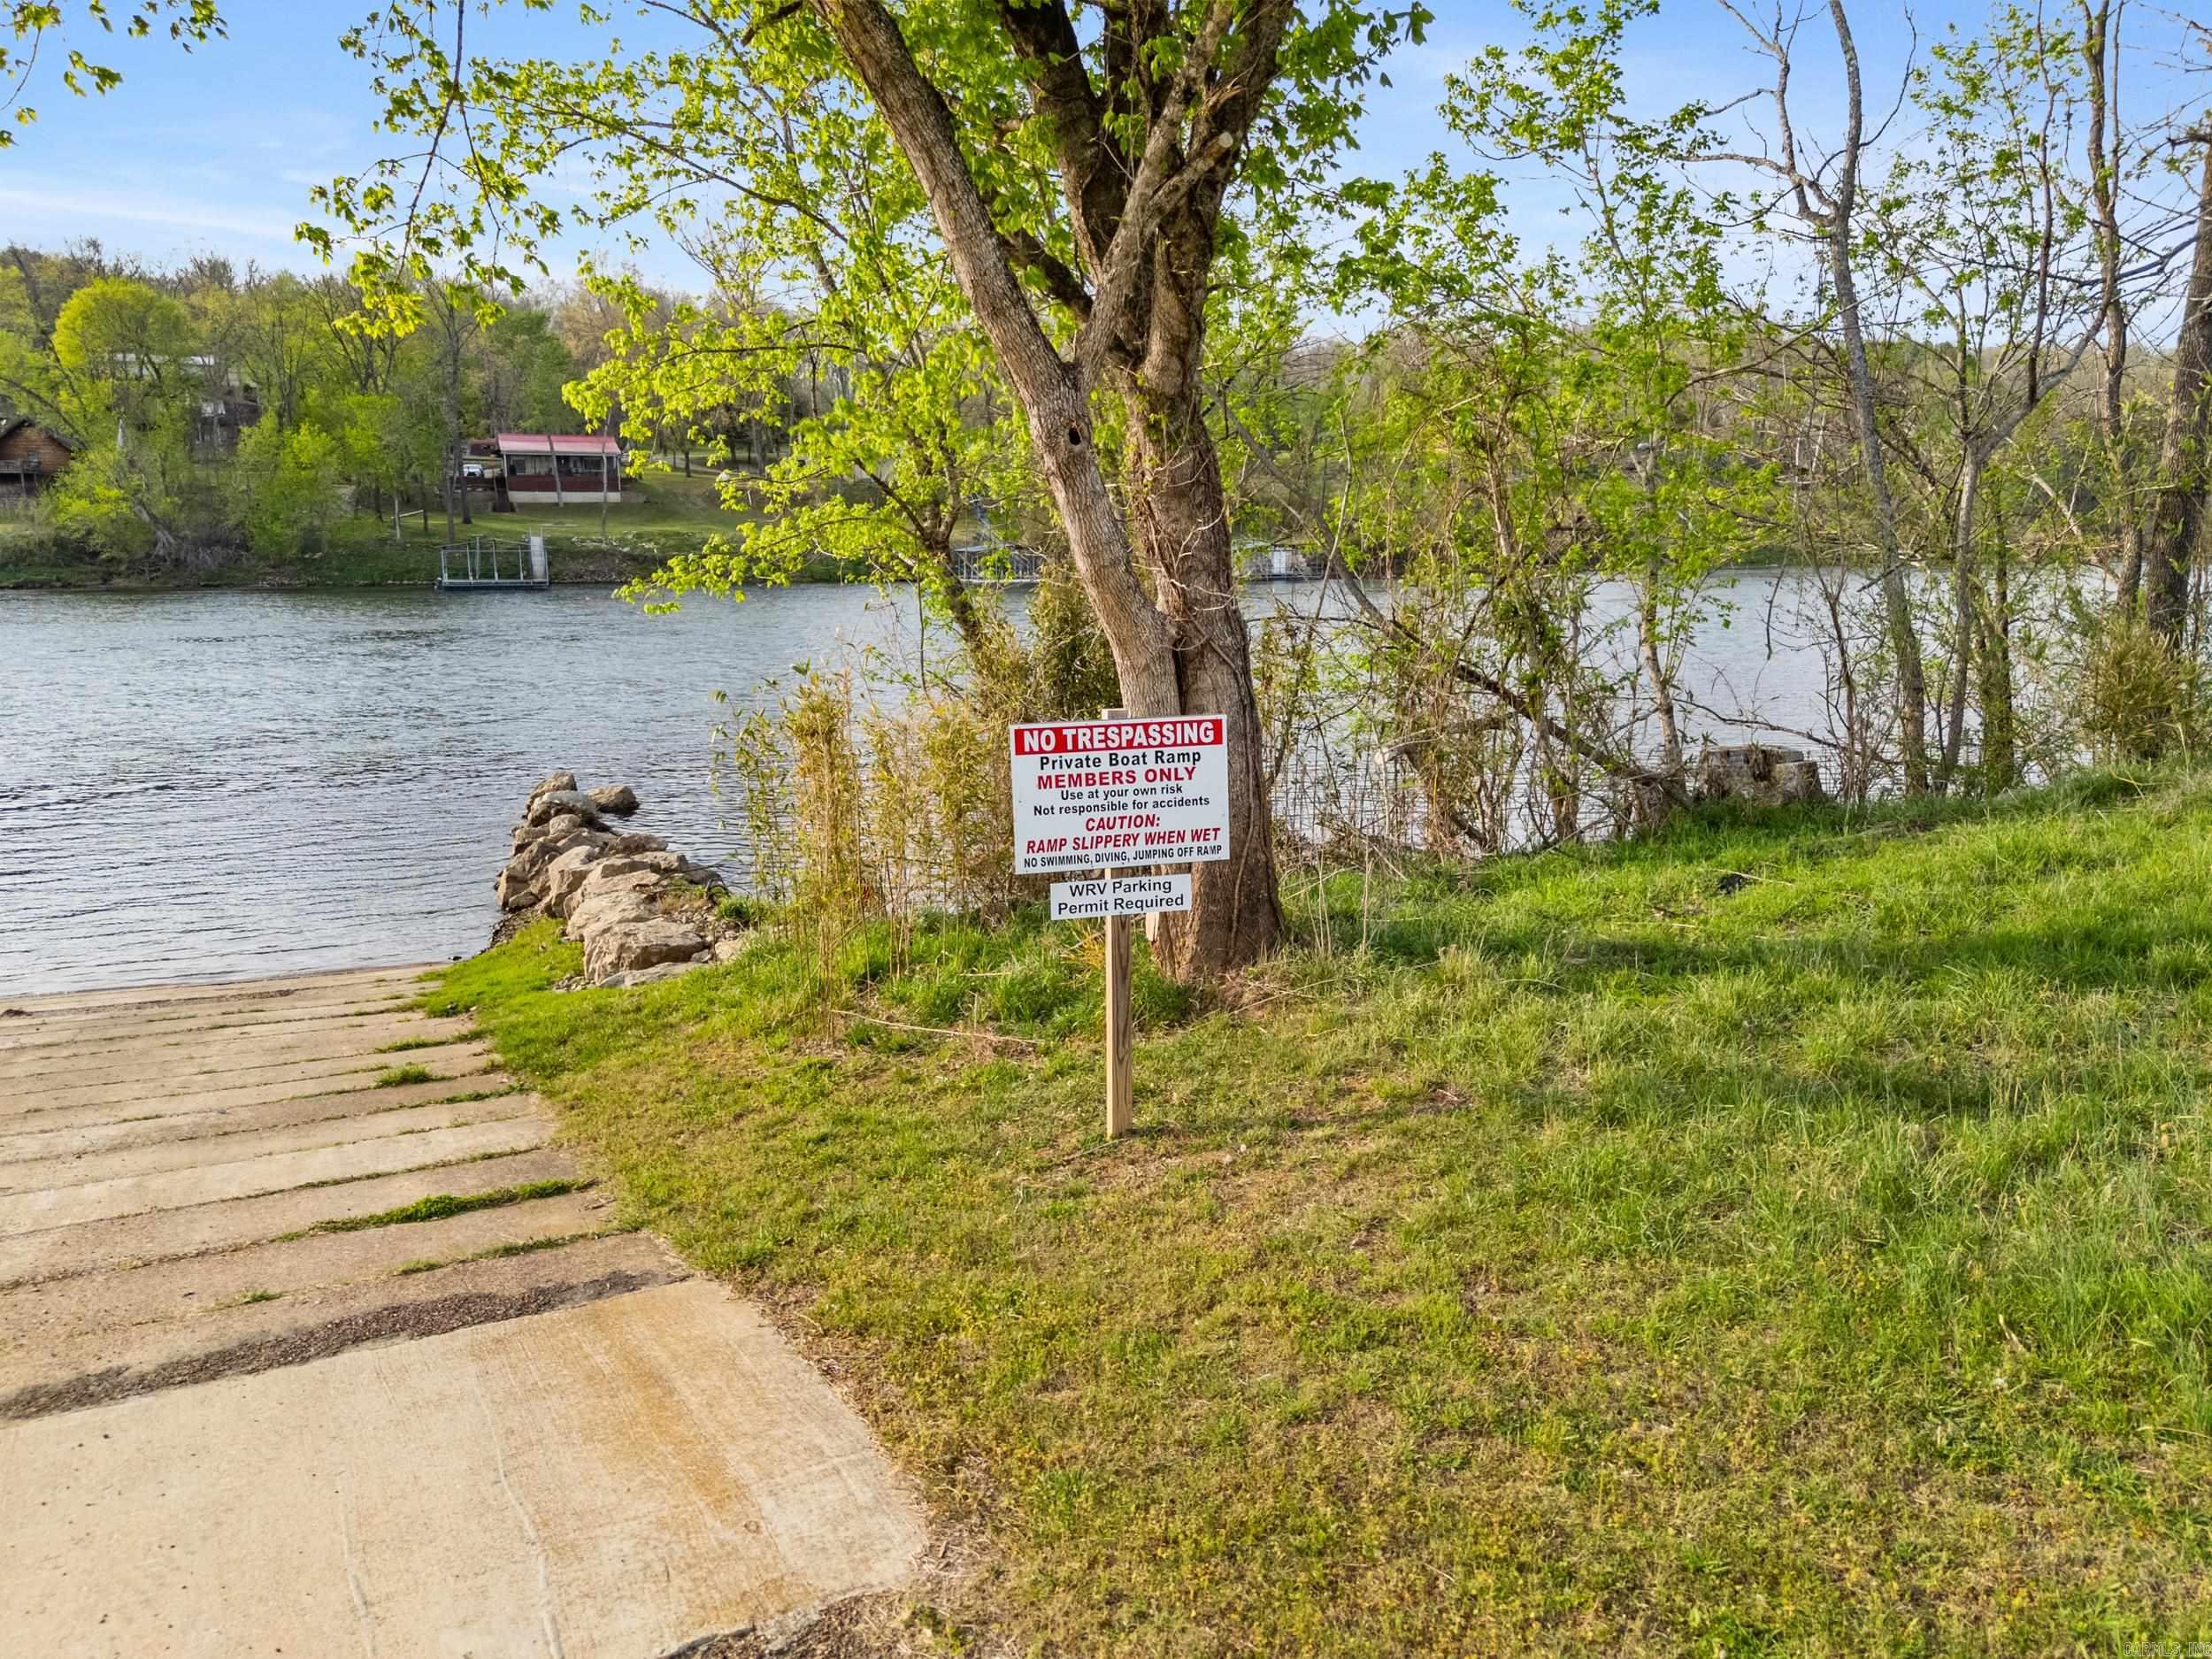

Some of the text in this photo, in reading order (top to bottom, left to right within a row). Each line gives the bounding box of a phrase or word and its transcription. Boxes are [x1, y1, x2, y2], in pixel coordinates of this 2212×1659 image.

[1024, 722, 1214, 752] NO TRESPASSING
[1041, 750, 1201, 770] Private Boat Ramp
[1038, 767, 1196, 789] MEMBERS ONLY
[1061, 785, 1182, 800] Use at your own risk
[1034, 805, 1055, 815] Not
[1059, 801, 1128, 815] responsible
[1153, 796, 1210, 808] accidents
[1086, 815, 1161, 832] CAUTION:
[1027, 828, 1220, 854] RAMP SLIPPERY WHEN WET
[1025, 845, 1222, 867] NO SWIMMING, DIVING, JUMPING OFF RAMP
[1070, 879, 1171, 896] WRV Parking
[1058, 895, 1183, 915] Permit Required
